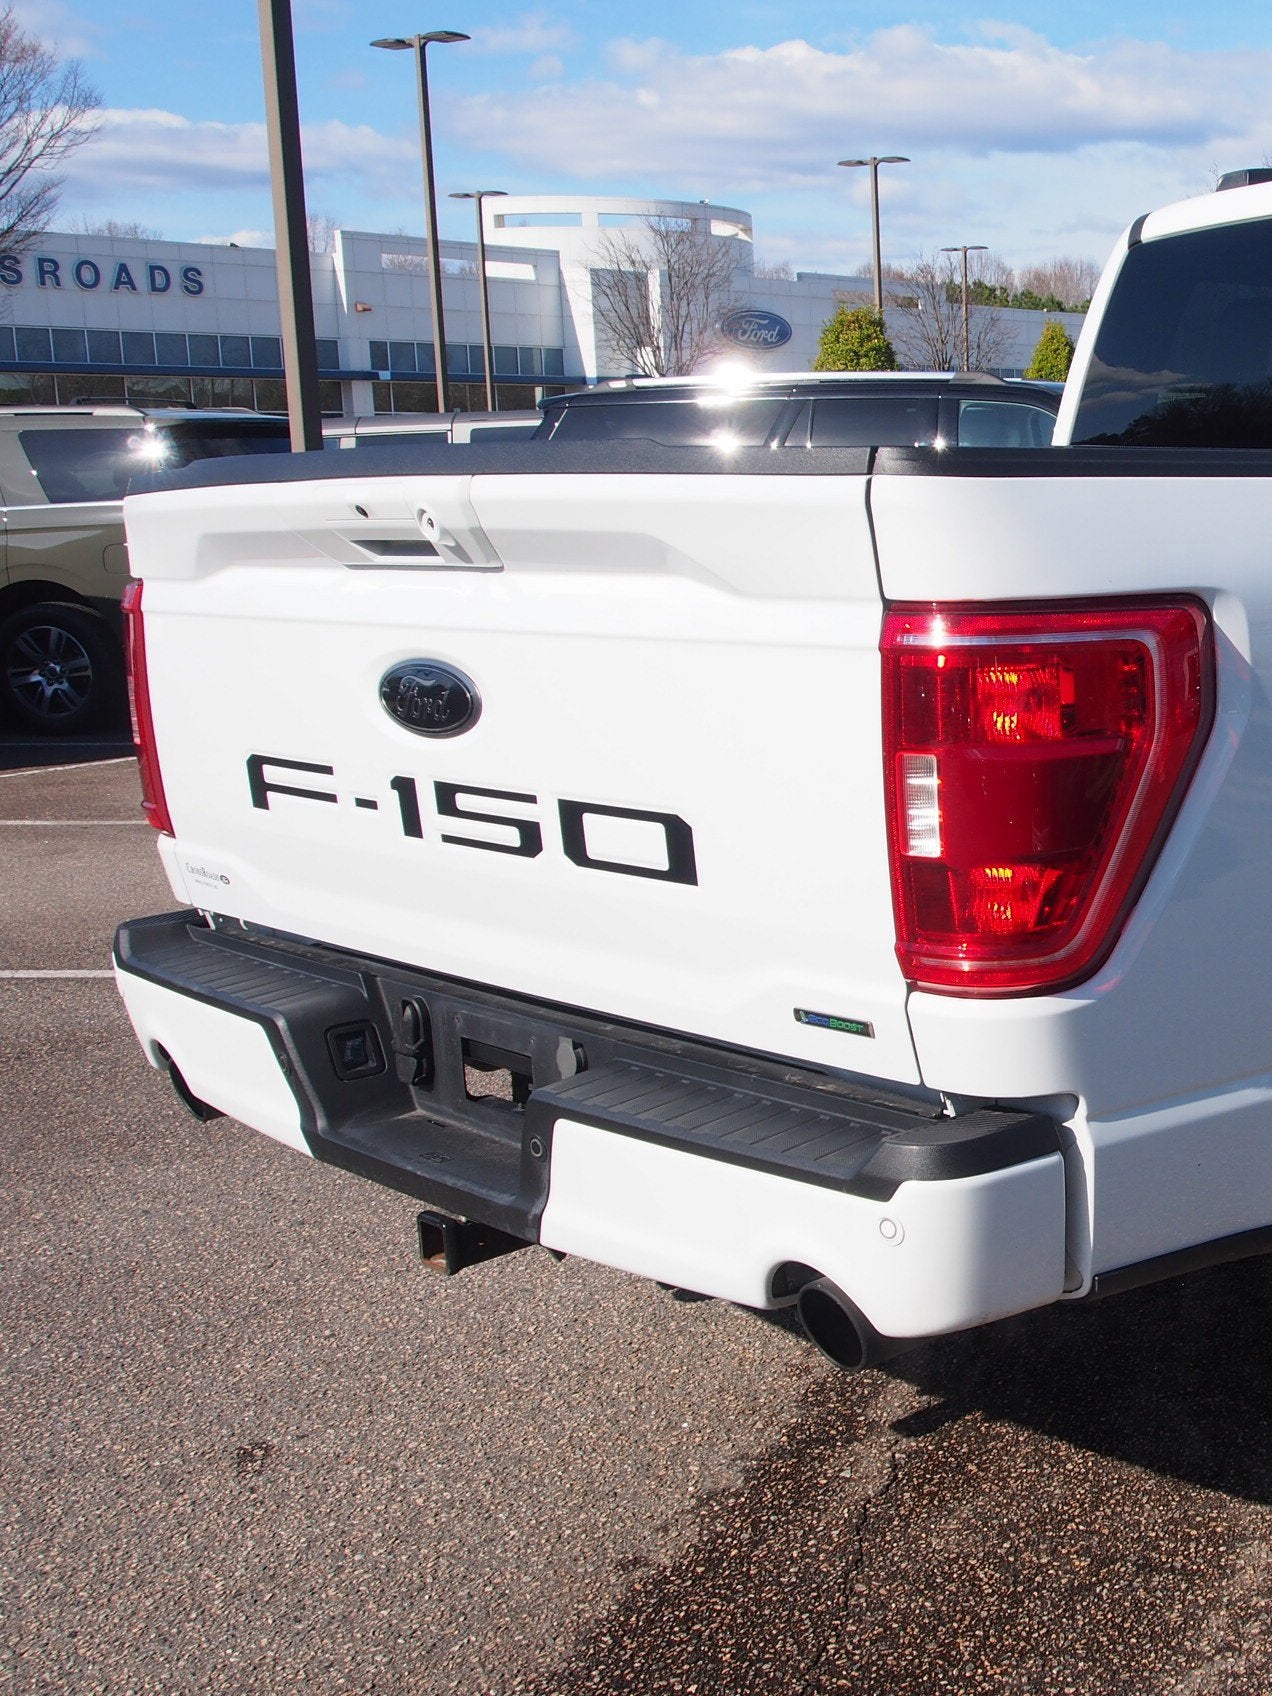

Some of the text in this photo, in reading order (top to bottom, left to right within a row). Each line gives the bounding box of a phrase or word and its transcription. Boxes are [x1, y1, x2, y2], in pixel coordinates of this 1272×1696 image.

[0, 254, 206, 297] SROADS
[738, 317, 780, 342] Ford
[396, 675, 450, 721] Ford
[246, 753, 699, 887] F-150
